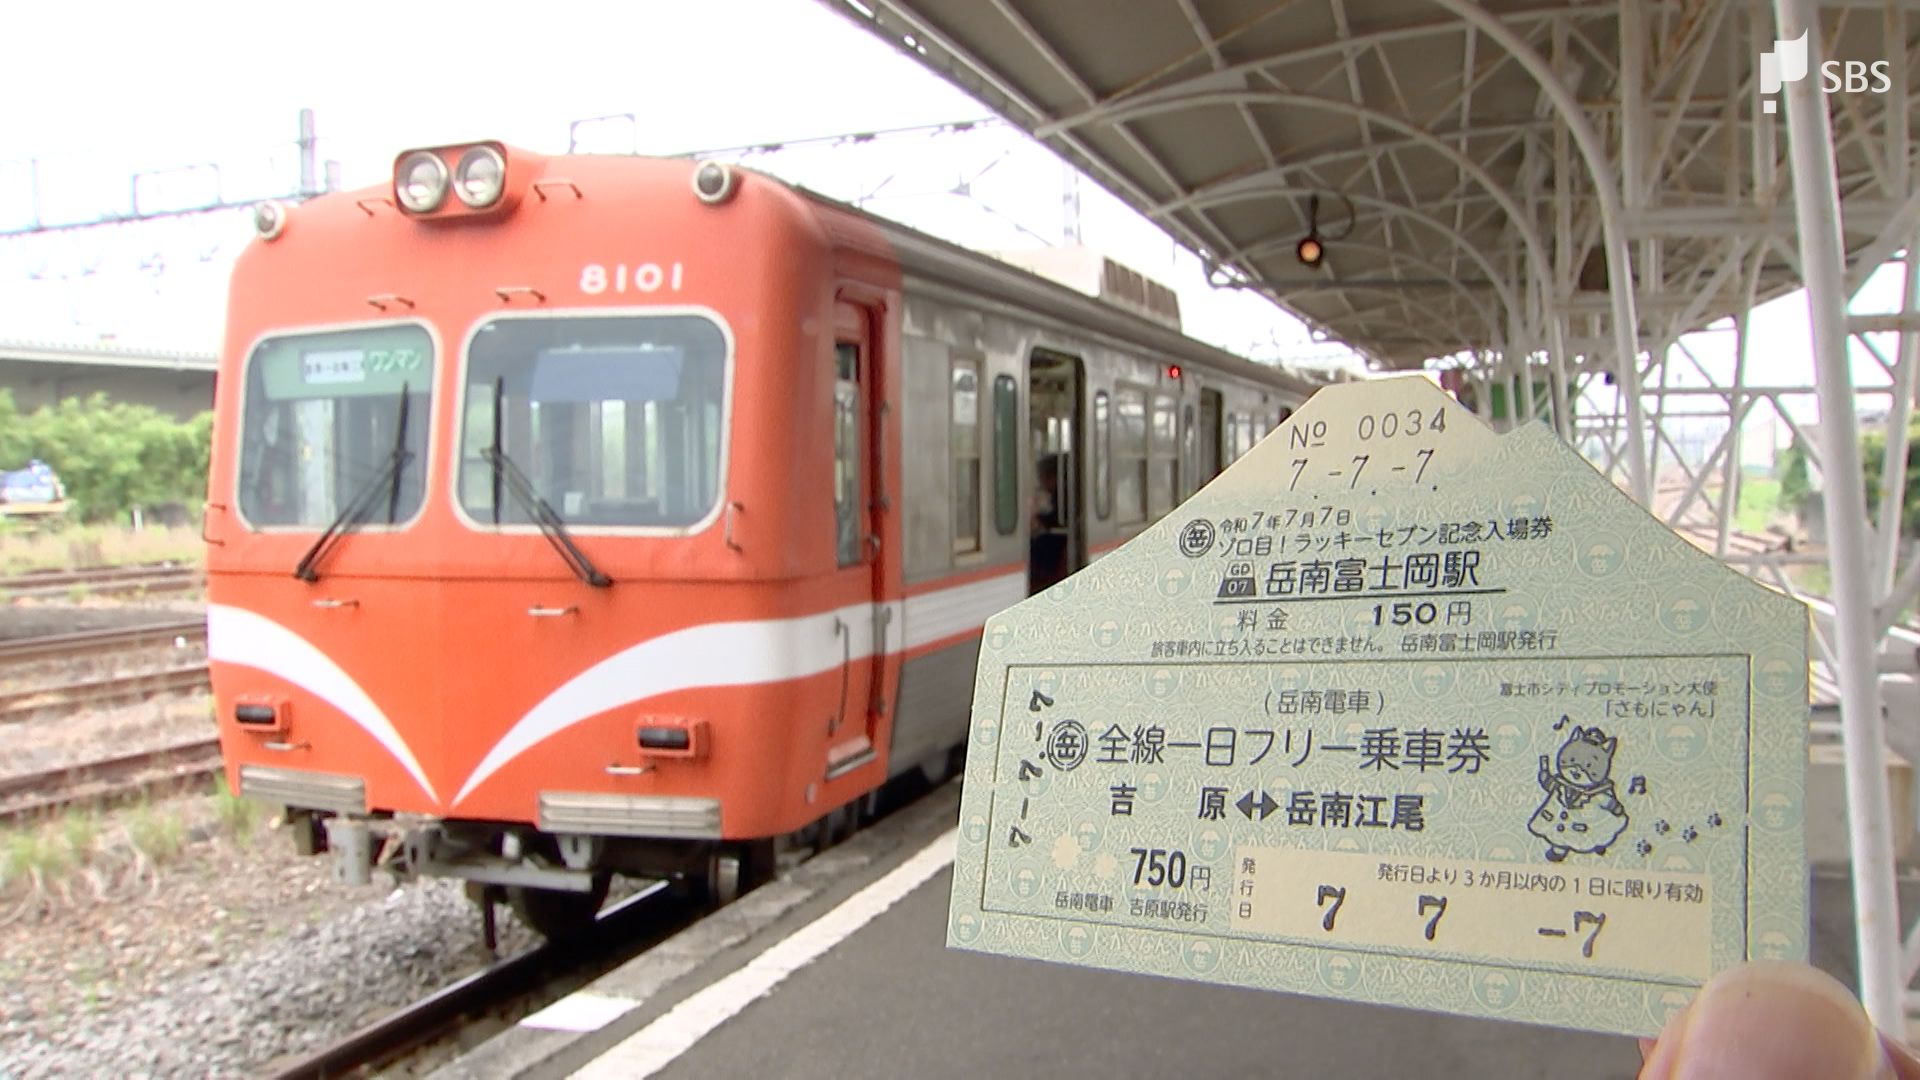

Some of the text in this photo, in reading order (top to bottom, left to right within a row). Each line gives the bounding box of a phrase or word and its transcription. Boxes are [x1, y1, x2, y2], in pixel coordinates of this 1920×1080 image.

[579, 262, 683, 295] 8101
[1358, 407, 1447, 441] 0034
[1219, 506, 1351, 534] 令和7年7月7日
[1230, 563, 1251, 577] GD
[1265, 551, 1481, 597] 岳南富士岡駅
[1227, 580, 1249, 595] 07
[1151, 630, 1558, 658] 旅客車内に立ち入ることはできません。 岳南富士岡駅発行
[1264, 688, 1385, 716] （岳南電車）
[1095, 723, 1491, 774] 全線一日フリー乗車券
[1285, 790, 1425, 832] 岳南江尾
[1238, 856, 1257, 919] 発行日
[1054, 891, 1209, 923] 岳南電車 吉原駅発行
[1316, 884, 1347, 932] 7
[1417, 894, 1448, 941] 7
